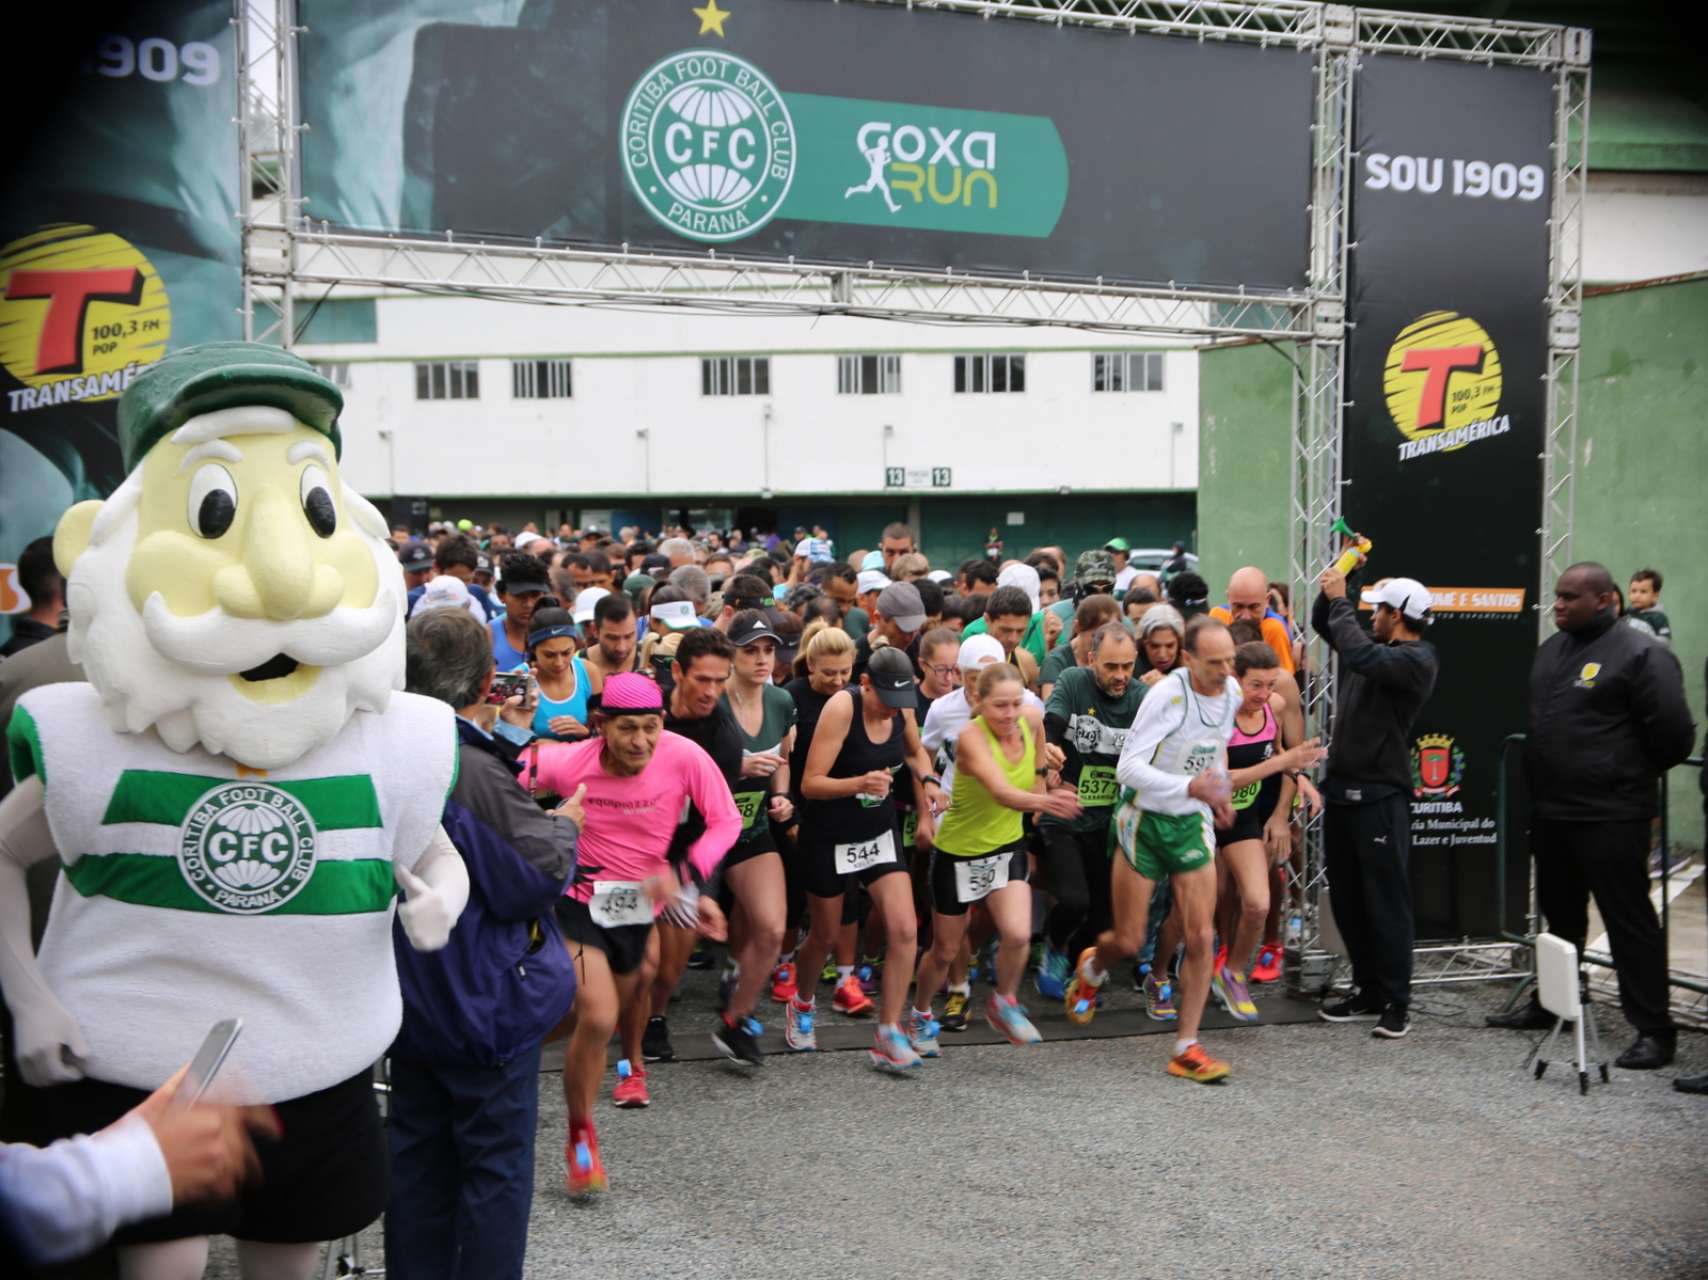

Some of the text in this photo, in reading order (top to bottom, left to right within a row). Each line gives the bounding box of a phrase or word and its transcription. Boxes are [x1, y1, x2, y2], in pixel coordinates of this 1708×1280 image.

[86, 34, 220, 86] 909
[628, 57, 790, 181] CORITIBA FOOT BALL CLUB
[664, 121, 756, 170] CFC
[1364, 152, 1545, 201] SOU 1909
[667, 201, 751, 233] PARANÁ
[92, 319, 160, 341] 100,3 FM
[92, 342, 118, 356] POP
[1398, 414, 1511, 461] TRANSAMÉRICA
[887, 467, 904, 486] 13
[933, 467, 950, 486] 13
[1471, 592, 1521, 608] SANTOS
[182, 788, 313, 881] CORITIBA FOOT BALL CLUB
[1427, 817, 1480, 832] Municipal
[1481, 817, 1496, 829] do
[208, 831, 289, 863] CFC
[1412, 832, 1498, 847] Lazer e Juventud
[846, 843, 881, 864] 544
[213, 886, 282, 908] PARANÁ
